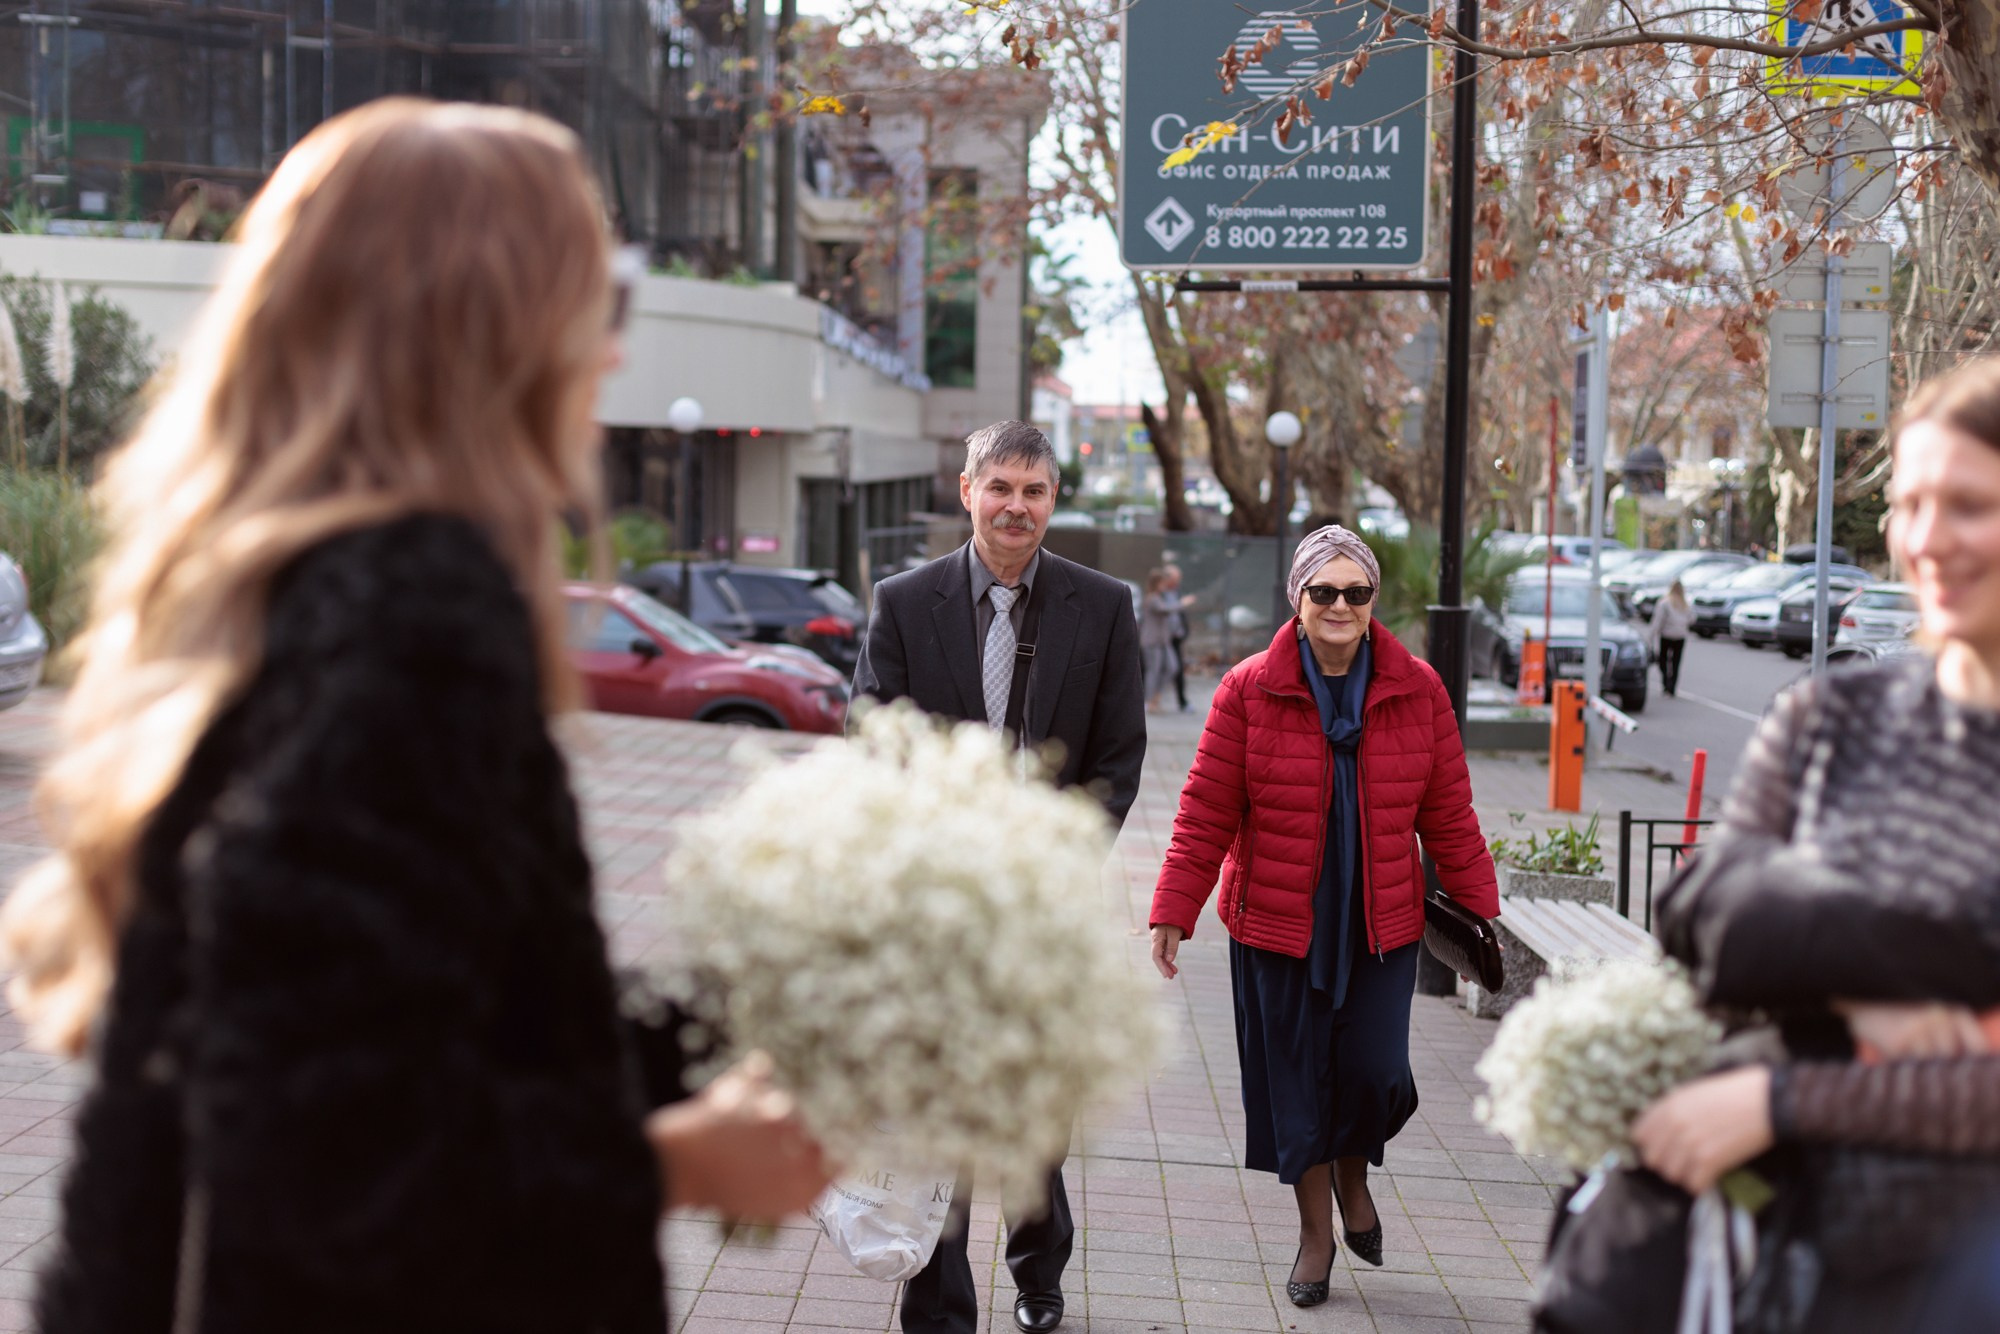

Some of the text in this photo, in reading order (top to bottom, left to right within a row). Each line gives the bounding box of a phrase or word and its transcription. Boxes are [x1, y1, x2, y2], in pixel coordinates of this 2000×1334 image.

[1150, 113, 1400, 154] Сан-Сити
[1157, 164, 1391, 181] ОФИС ОТДЕЛА ПРОДАЖ
[1206, 203, 1387, 221] Курортный проспект 108
[1205, 225, 1408, 249] 8 800 222 22 25
